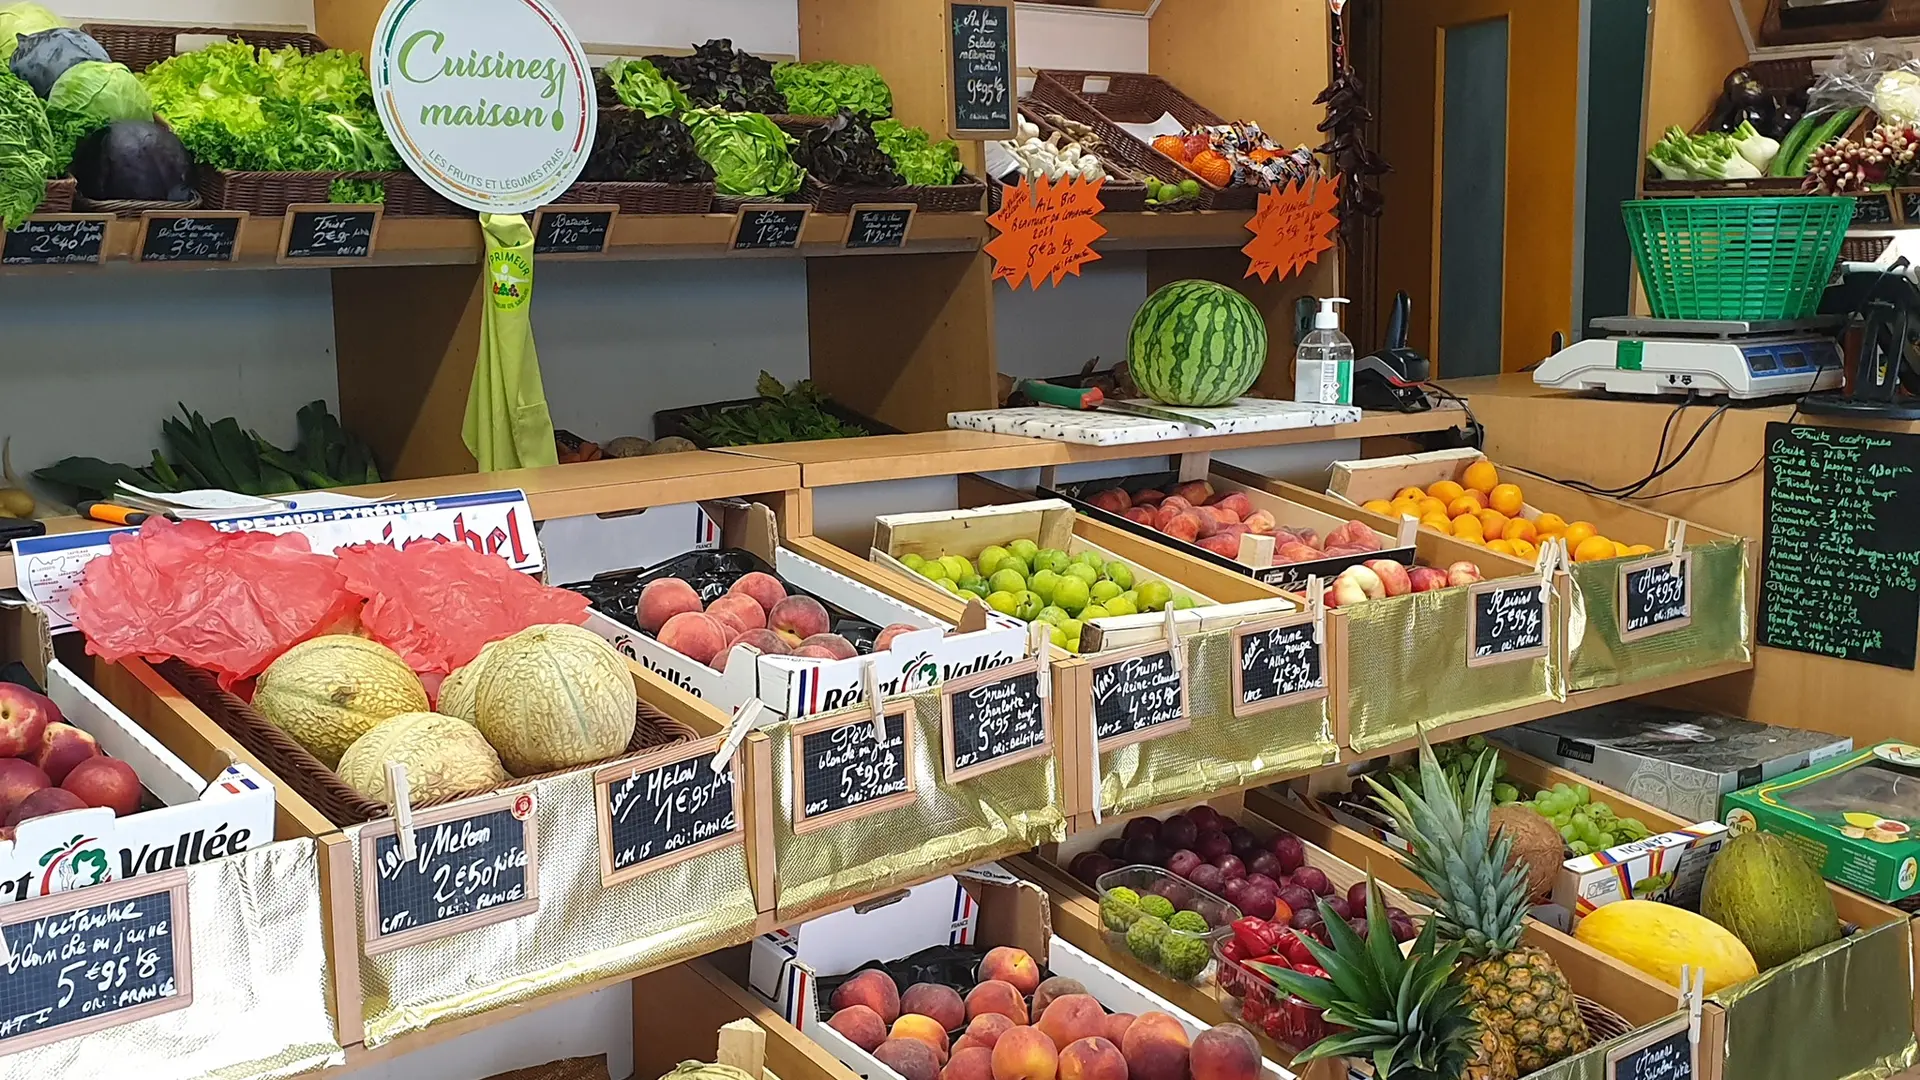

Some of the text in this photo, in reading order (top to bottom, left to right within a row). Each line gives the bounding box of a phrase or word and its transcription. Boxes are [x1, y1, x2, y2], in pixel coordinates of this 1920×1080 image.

[397, 29, 558, 98] Cuisines
[420, 98, 548, 128] maison
[428, 148, 564, 190] LES FRUITS ET LÉGUMES FRAIS
[490, 252, 530, 276] PRIMEUR
[1791, 427, 1830, 441] Fruits
[238, 517, 268, 532] DE
[273, 500, 438, 527] MIDI-PYRÉNÉES
[1268, 627, 1303, 649] Prune
[1120, 656, 1165, 682] Prune
[1128, 688, 1163, 722] 4€95
[840, 760, 884, 798] 5€95
[654, 784, 713, 832] 1€95
[119, 822, 251, 880] Vallée
[418, 820, 491, 875] Melon
[432, 857, 491, 903] 2€50
[113, 920, 169, 955] jaune
[57, 956, 130, 1009] 5€95
